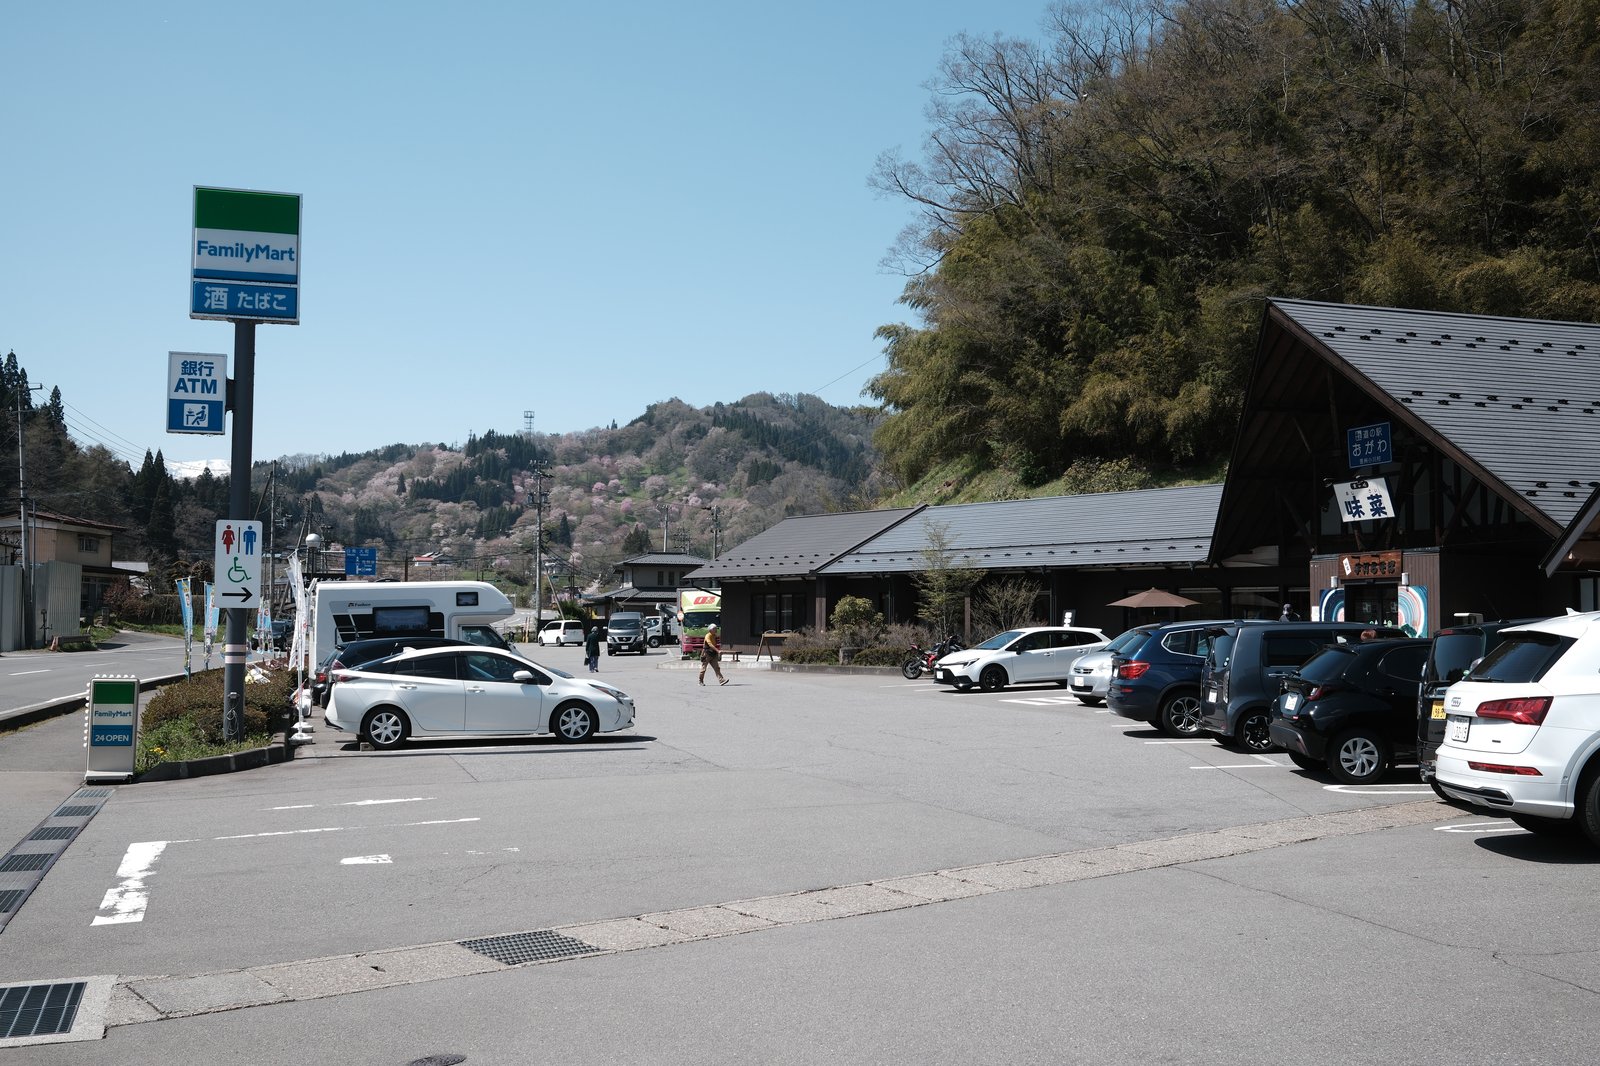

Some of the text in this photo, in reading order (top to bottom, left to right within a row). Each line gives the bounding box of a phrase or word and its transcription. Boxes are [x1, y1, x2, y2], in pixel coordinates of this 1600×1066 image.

[196, 240, 295, 263] FamilyMart
[203, 286, 287, 311] 酒 たばこ
[181, 360, 214, 377] 銀行
[173, 377, 217, 395] ATM
[1352, 439, 1387, 457] おがわ
[1344, 494, 1388, 518] 味菜
[94, 710, 132, 718] FamilyMart
[95, 734, 129, 742] 24 OPEN
